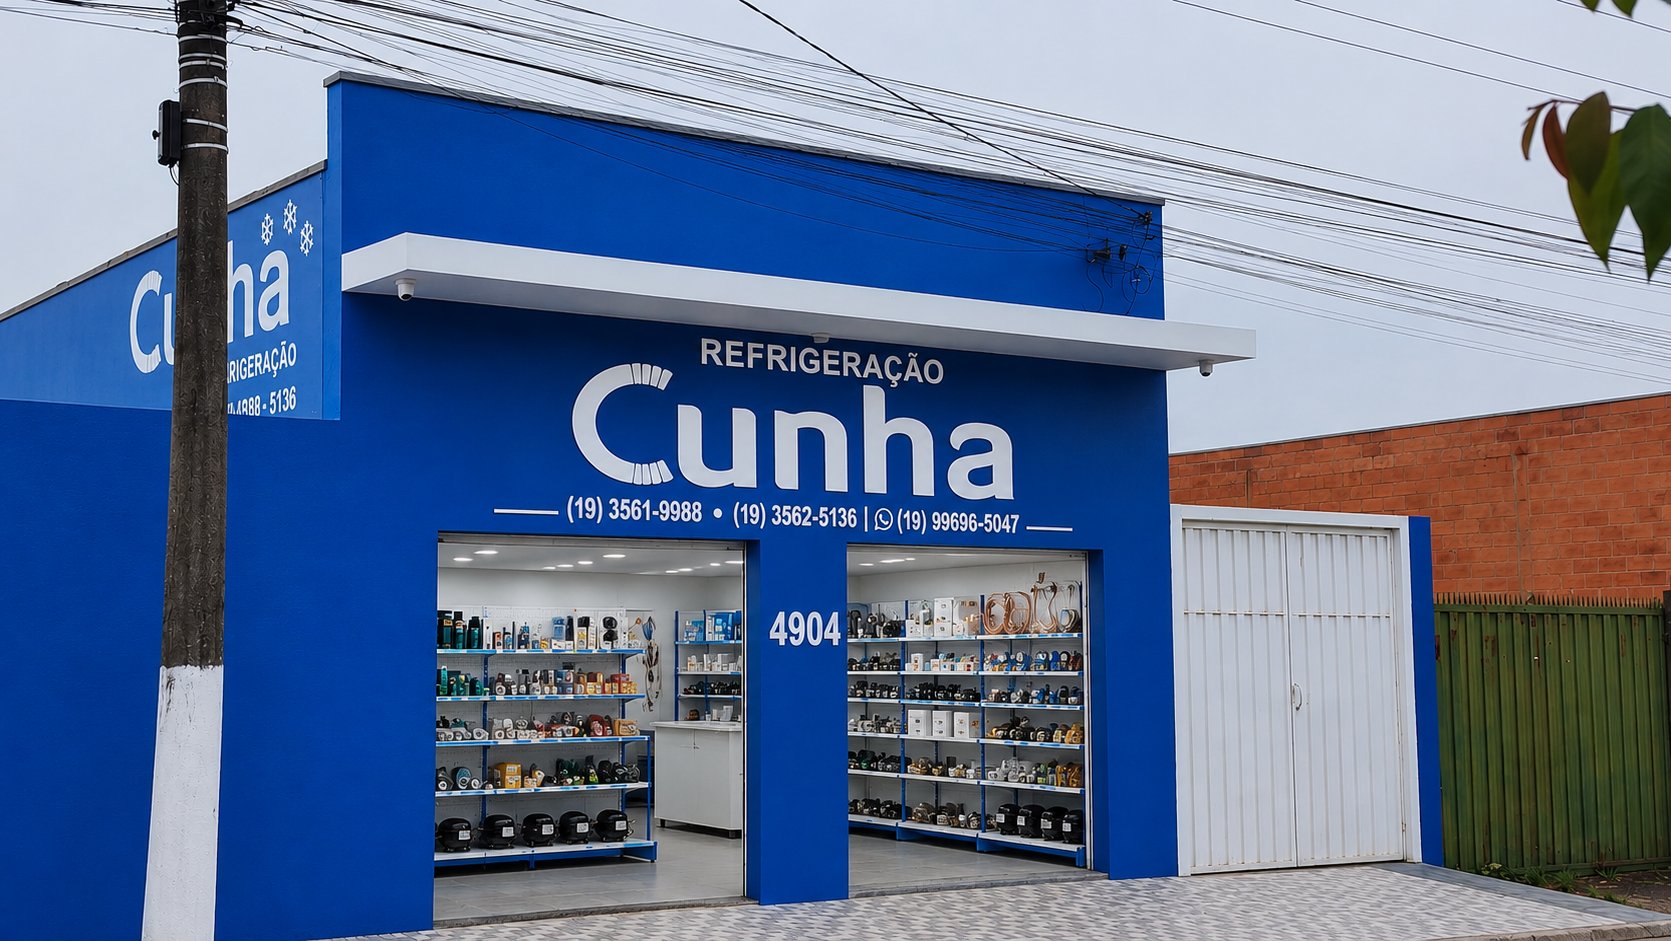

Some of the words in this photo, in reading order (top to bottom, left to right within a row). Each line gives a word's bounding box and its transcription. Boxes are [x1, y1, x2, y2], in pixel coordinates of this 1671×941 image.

[130, 240, 290, 374] Cuha
[226, 340, 298, 385] RIGERAÇÃO
[701, 338, 945, 389] REFRIGERAÇÃO
[269, 385, 297, 415] 5136
[571, 362, 1015, 500] Cunha
[567, 495, 603, 524] (19)
[608, 497, 703, 523] 3561-9988
[733, 501, 766, 530] (19)
[771, 504, 857, 529] 3562-5136
[897, 508, 927, 535] (19)
[931, 511, 1020, 535] 99696-5047
[769, 611, 841, 646] 4904
